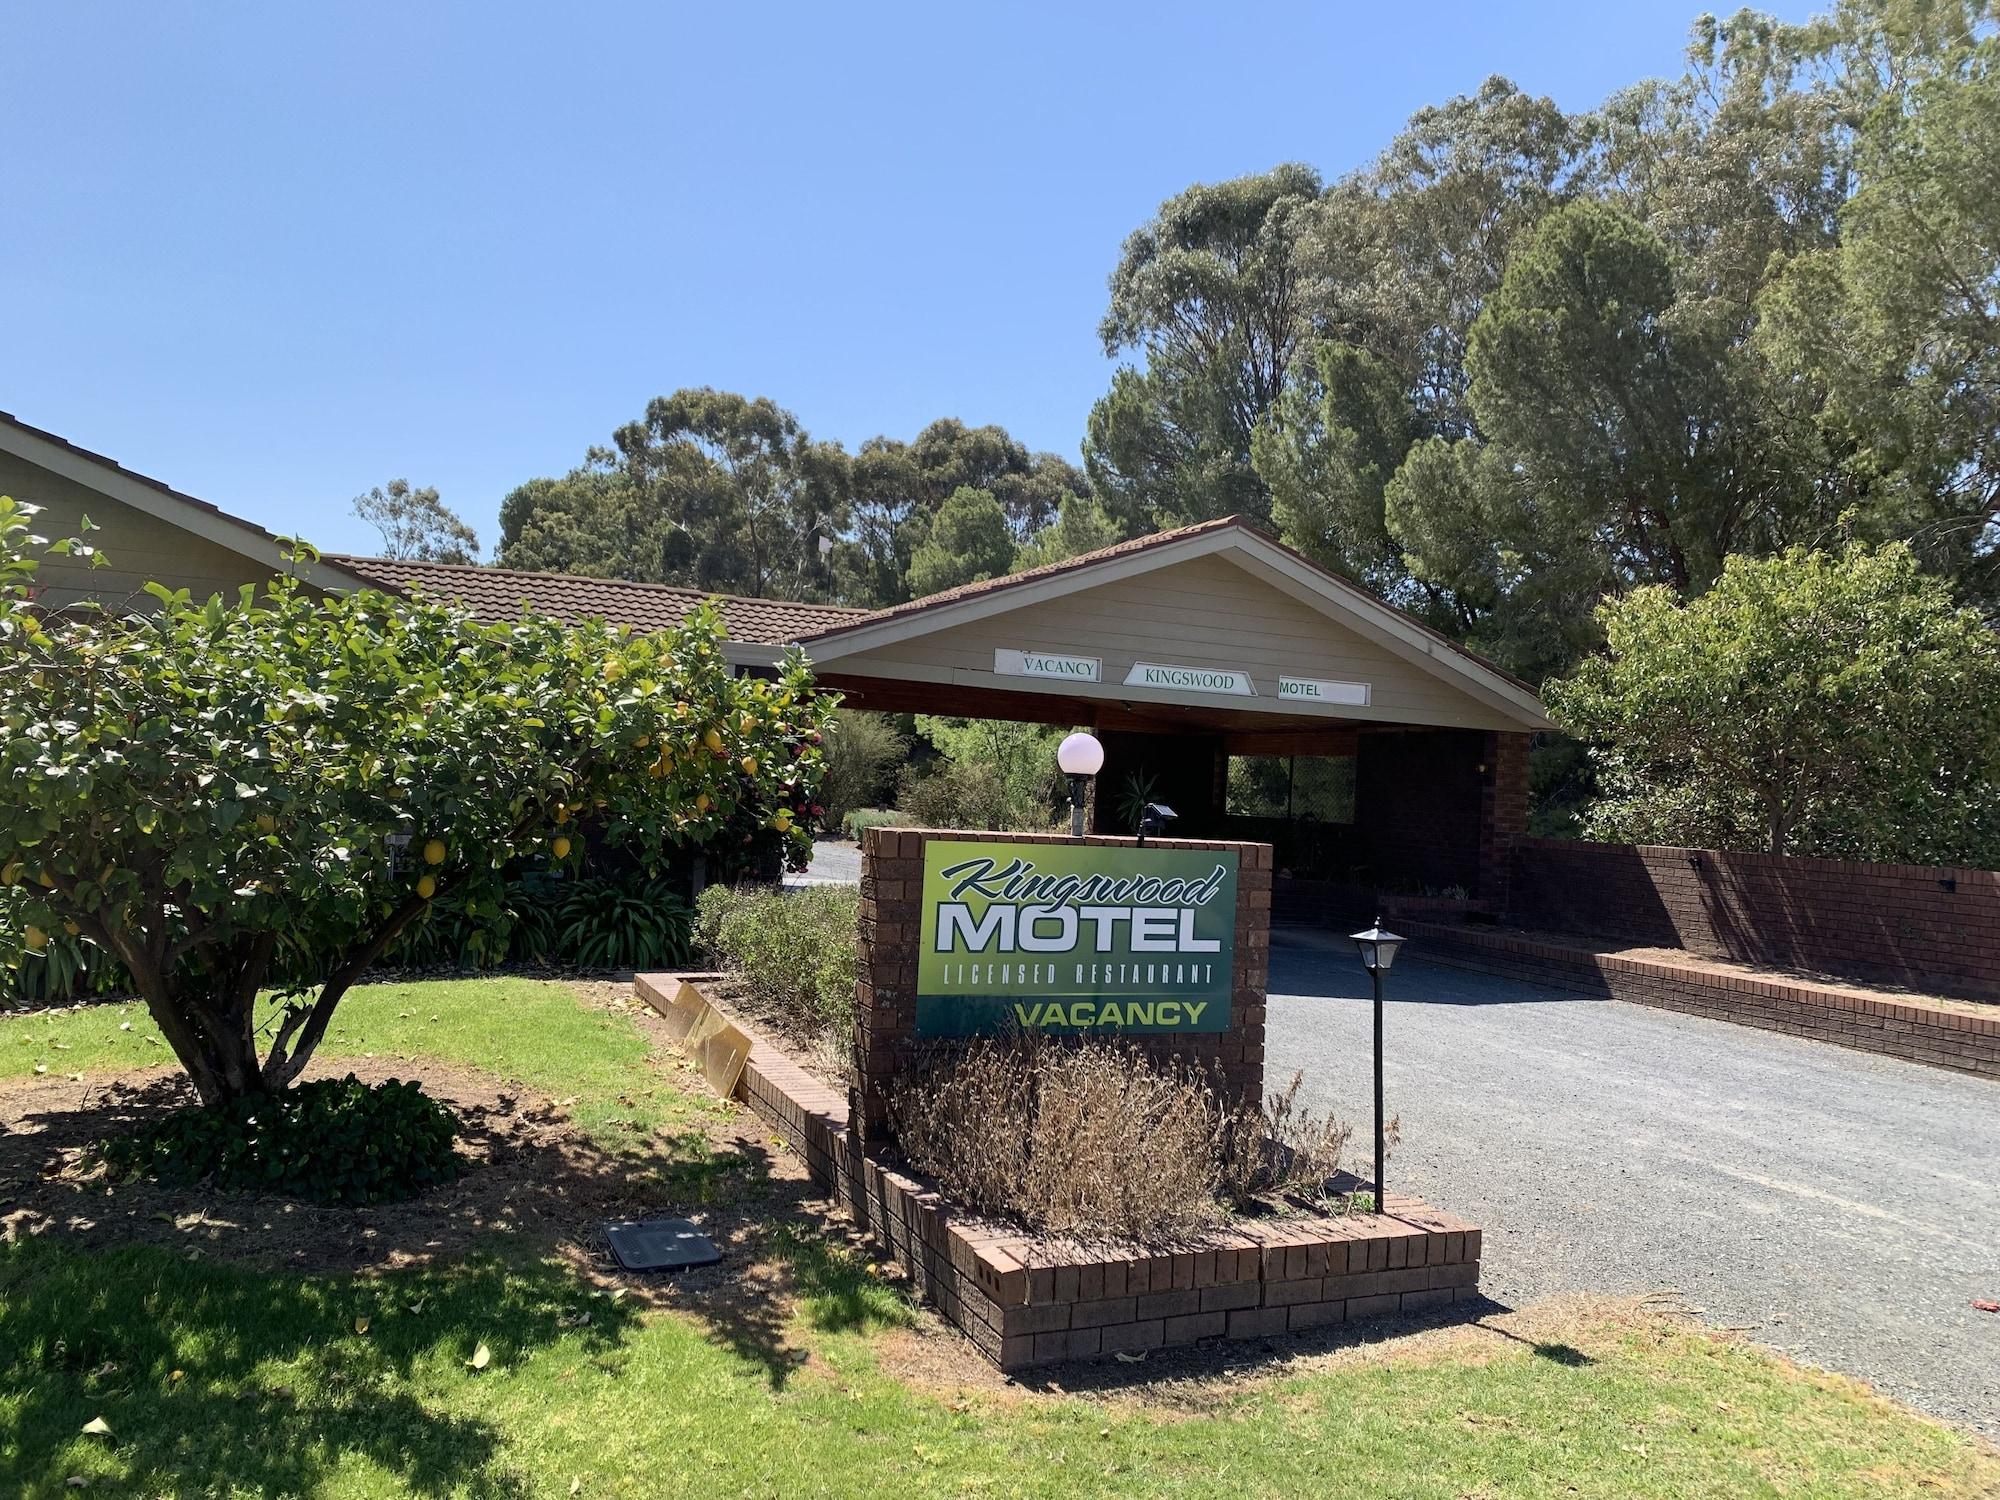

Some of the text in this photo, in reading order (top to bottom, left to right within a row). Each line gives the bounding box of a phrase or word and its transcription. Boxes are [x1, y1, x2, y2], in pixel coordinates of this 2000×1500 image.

[1024, 658, 1094, 676] VACANCY
[1145, 668, 1234, 689] KINGSWOOD
[1280, 682, 1321, 696] MOTEL
[940, 857, 1226, 913] Kingswood
[935, 901, 1221, 952] MOTEL
[943, 964, 1212, 984] LICENSED RESTAURANT
[1014, 1002, 1208, 1027] VACANCY
